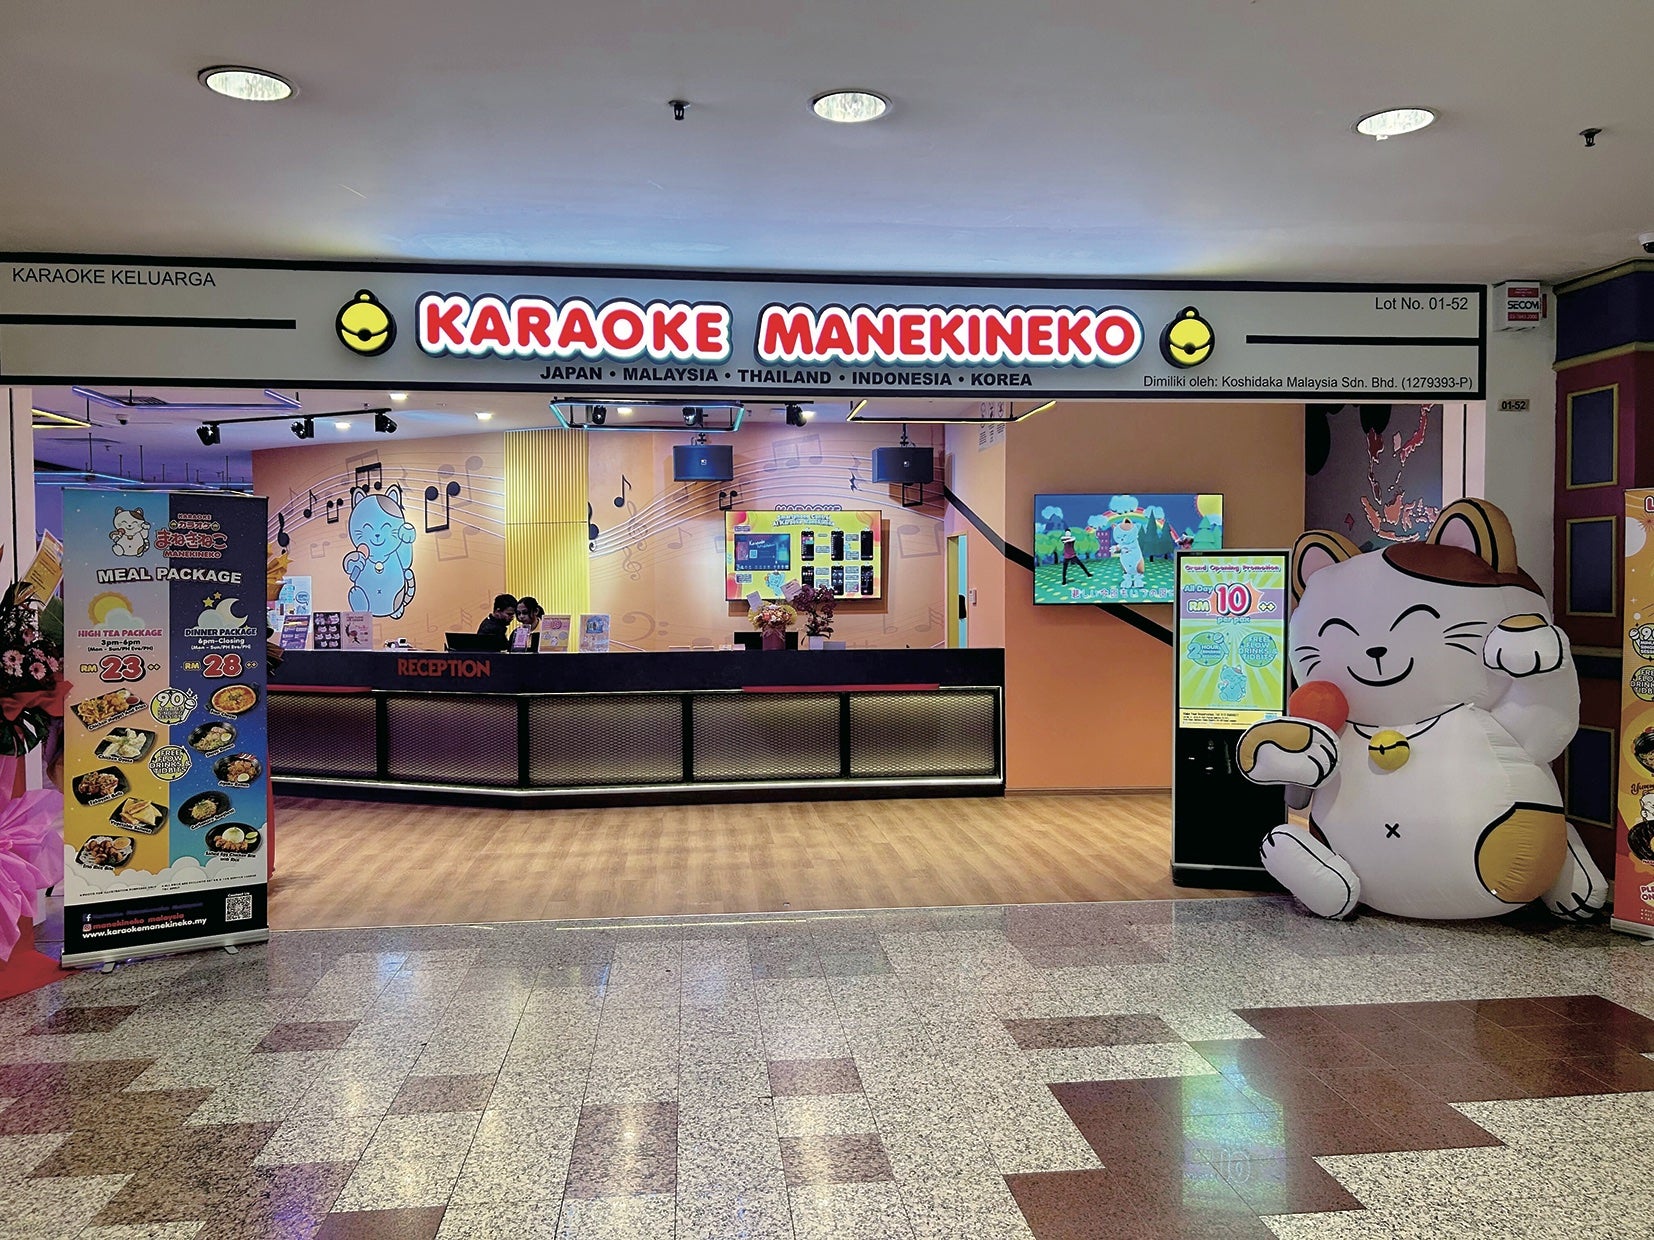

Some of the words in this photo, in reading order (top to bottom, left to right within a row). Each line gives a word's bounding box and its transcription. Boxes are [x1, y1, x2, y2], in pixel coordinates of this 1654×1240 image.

[12, 267, 105, 285] KARAOKE
[111, 269, 216, 287] KELUARGA
[1375, 297, 1397, 310] Lot
[1401, 297, 1425, 310] No.
[1428, 297, 1468, 310] 01-52
[1507, 300, 1539, 310] SECOM
[420, 297, 729, 357] KARAOKE
[757, 304, 1142, 364] MANEKINEKO
[540, 366, 602, 381] JAPAN
[623, 367, 719, 382] MALAYSIA
[738, 369, 832, 384] THAILAND
[852, 371, 952, 386] INDONESIA
[970, 373, 1033, 387] KOREA
[1143, 375, 1187, 388] Dimiliki
[1189, 376, 1219, 388] oleh:
[1221, 376, 1285, 388] Koshidaka
[1287, 376, 1338, 390] Malaysia
[1341, 376, 1368, 388] Sdn.
[1371, 376, 1398, 388] Bhd.
[1401, 376, 1473, 391] (1279393-P)
[1501, 400, 1526, 410] 01-52
[177, 513, 212, 521] KARAOKE
[154, 527, 228, 551] まねきねこ
[163, 550, 222, 559] MANEKINEKO
[98, 568, 151, 583] MEAL
[156, 567, 242, 584] PACKAGE
[1196, 585, 1213, 594] Day
[1188, 601, 1210, 612] RM
[1216, 583, 1251, 616] 10
[122, 629, 162, 637] PACKAGE
[185, 628, 219, 637] DINNER
[219, 628, 257, 637] PACKAGE
[1641, 626, 1654, 641] 9
[198, 637, 245, 646] 6pm-Closing
[1187, 642, 1202, 659] 2
[80, 664, 98, 673] RM
[100, 655, 145, 682] 23
[184, 661, 201, 670] RM
[203, 653, 243, 678] 28
[397, 659, 491, 678] RECEPTION
[157, 692, 184, 707] 90
[82, 917, 208, 939] www.karaokemanekineko.my
